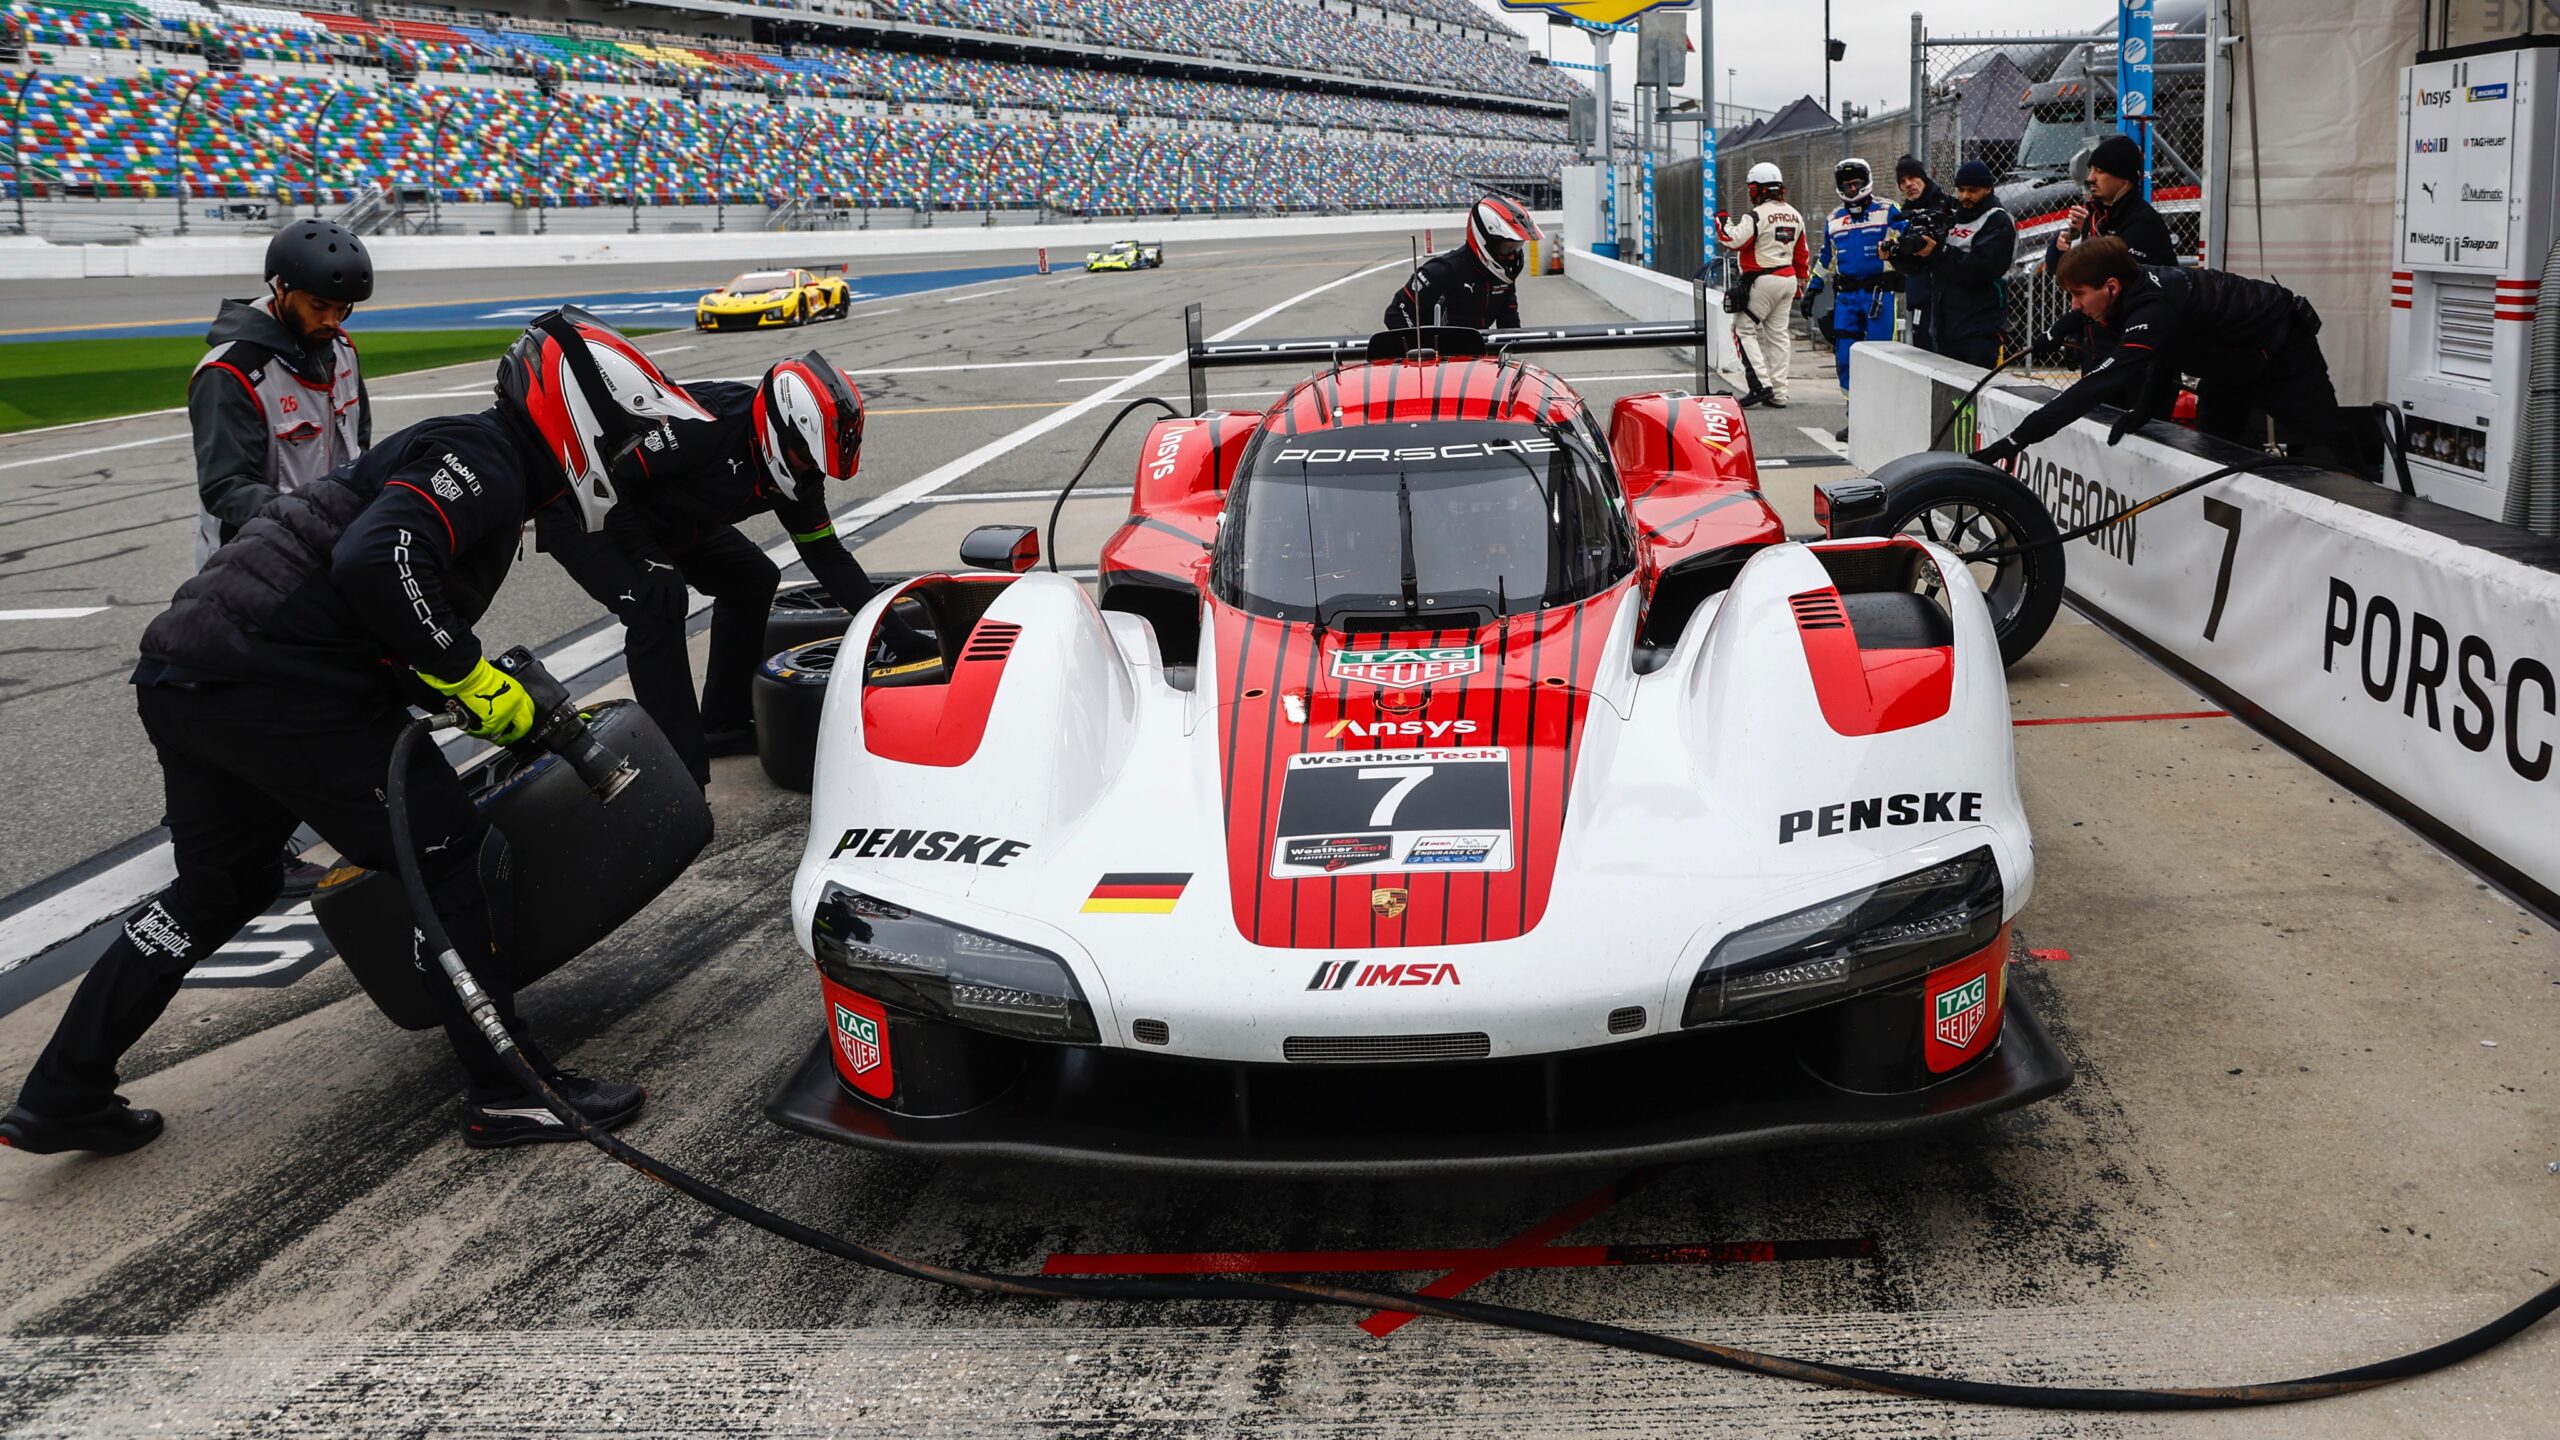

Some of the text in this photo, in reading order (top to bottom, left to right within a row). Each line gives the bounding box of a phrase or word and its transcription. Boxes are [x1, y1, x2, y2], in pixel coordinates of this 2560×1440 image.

[2416, 88, 2451, 108] Ansys
[2476, 88, 2505, 97] MICHELIN
[2415, 138, 2438, 153] Mobil
[2470, 188, 2503, 200] Multimatic
[1767, 213, 1800, 224] OFFICIAL
[2418, 233, 2444, 246] NetApp
[2460, 236, 2499, 251] Snap-on
[601, 371, 618, 393] PENSKE
[280, 395, 298, 413] 26
[1698, 402, 1734, 456] Ansys
[1149, 427, 1196, 480] Ansys
[1273, 437, 1560, 463] PORSCHE
[442, 453, 476, 484] Mobil
[440, 470, 461, 496] TAG
[2016, 450, 2137, 567] RACEBORN
[2202, 494, 2243, 643] 7
[394, 528, 454, 650] PORSCHE
[1349, 650, 1466, 663] TAG
[1342, 661, 1471, 684] HEUER
[2322, 575, 2557, 783] PORSC
[1324, 719, 1478, 738] Ansys
[1299, 749, 1502, 766] WeatherTech
[1357, 765, 1434, 827] 7
[1779, 791, 1983, 845] PENSKE
[830, 828, 1031, 868] PENSKE
[1290, 844, 1388, 856] WeatherTech
[132, 910, 192, 955] Mechanix
[1355, 963, 1461, 987] IMSA
[1941, 980, 1983, 1015] TAG
[838, 1009, 874, 1042] TAG
[1940, 1003, 1983, 1043] HEUER
[839, 1031, 877, 1069] HEUER
